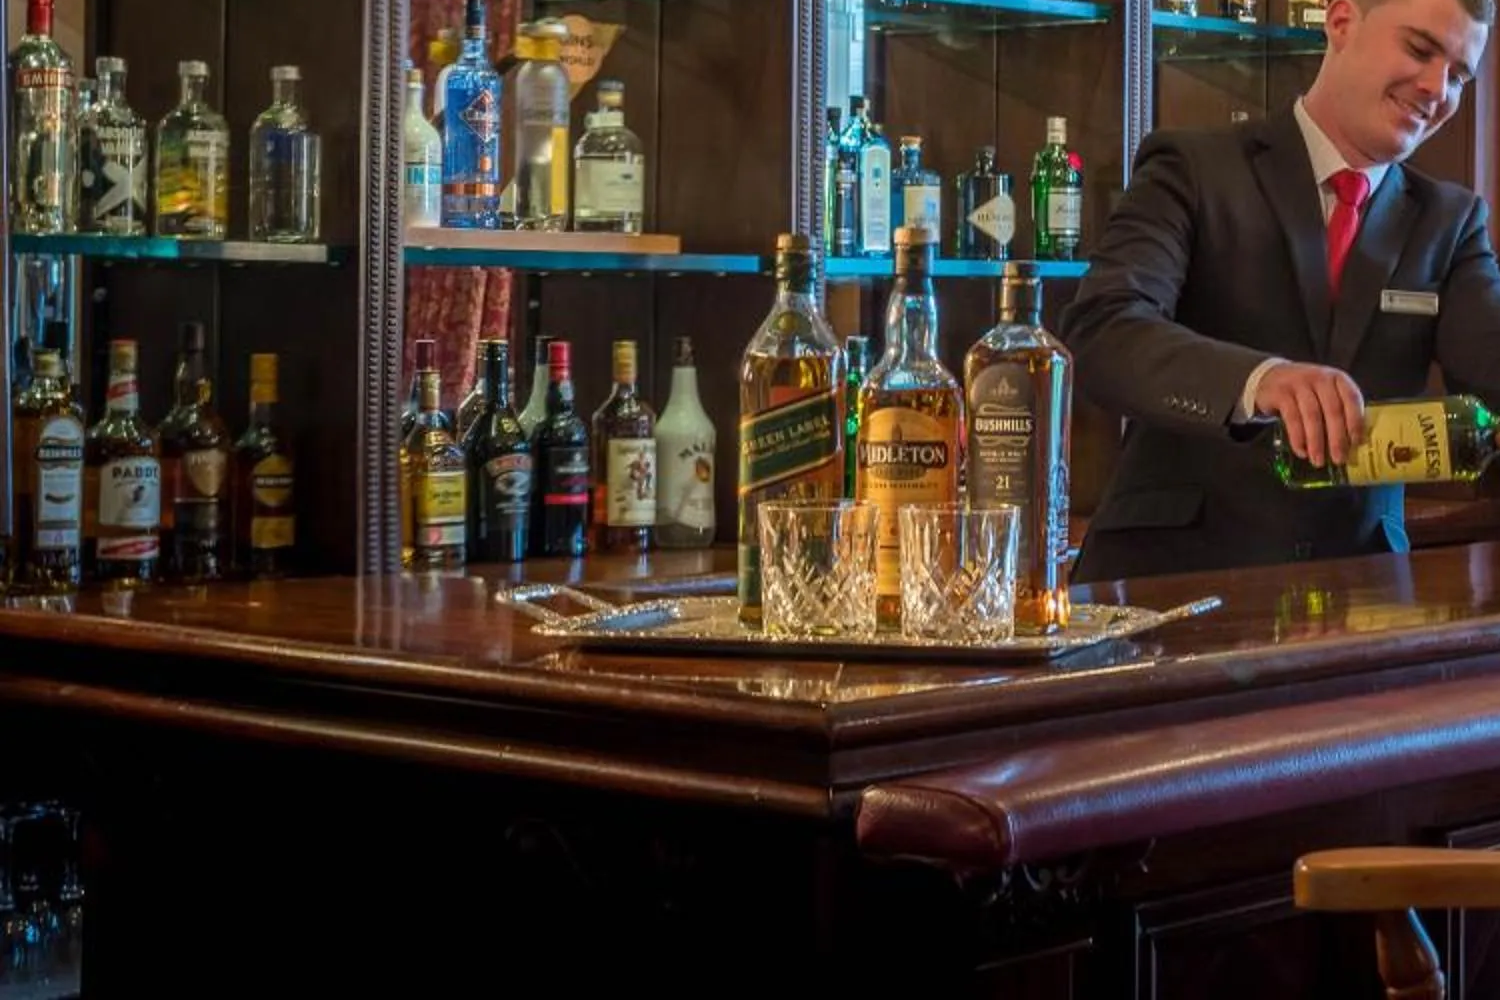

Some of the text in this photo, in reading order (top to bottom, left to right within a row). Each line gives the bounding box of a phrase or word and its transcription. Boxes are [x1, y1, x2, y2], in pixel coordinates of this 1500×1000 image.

[975, 417, 1033, 433] BUSHMILLS
[860, 443, 946, 467] MIDLETON
[995, 475, 1010, 490] 21
